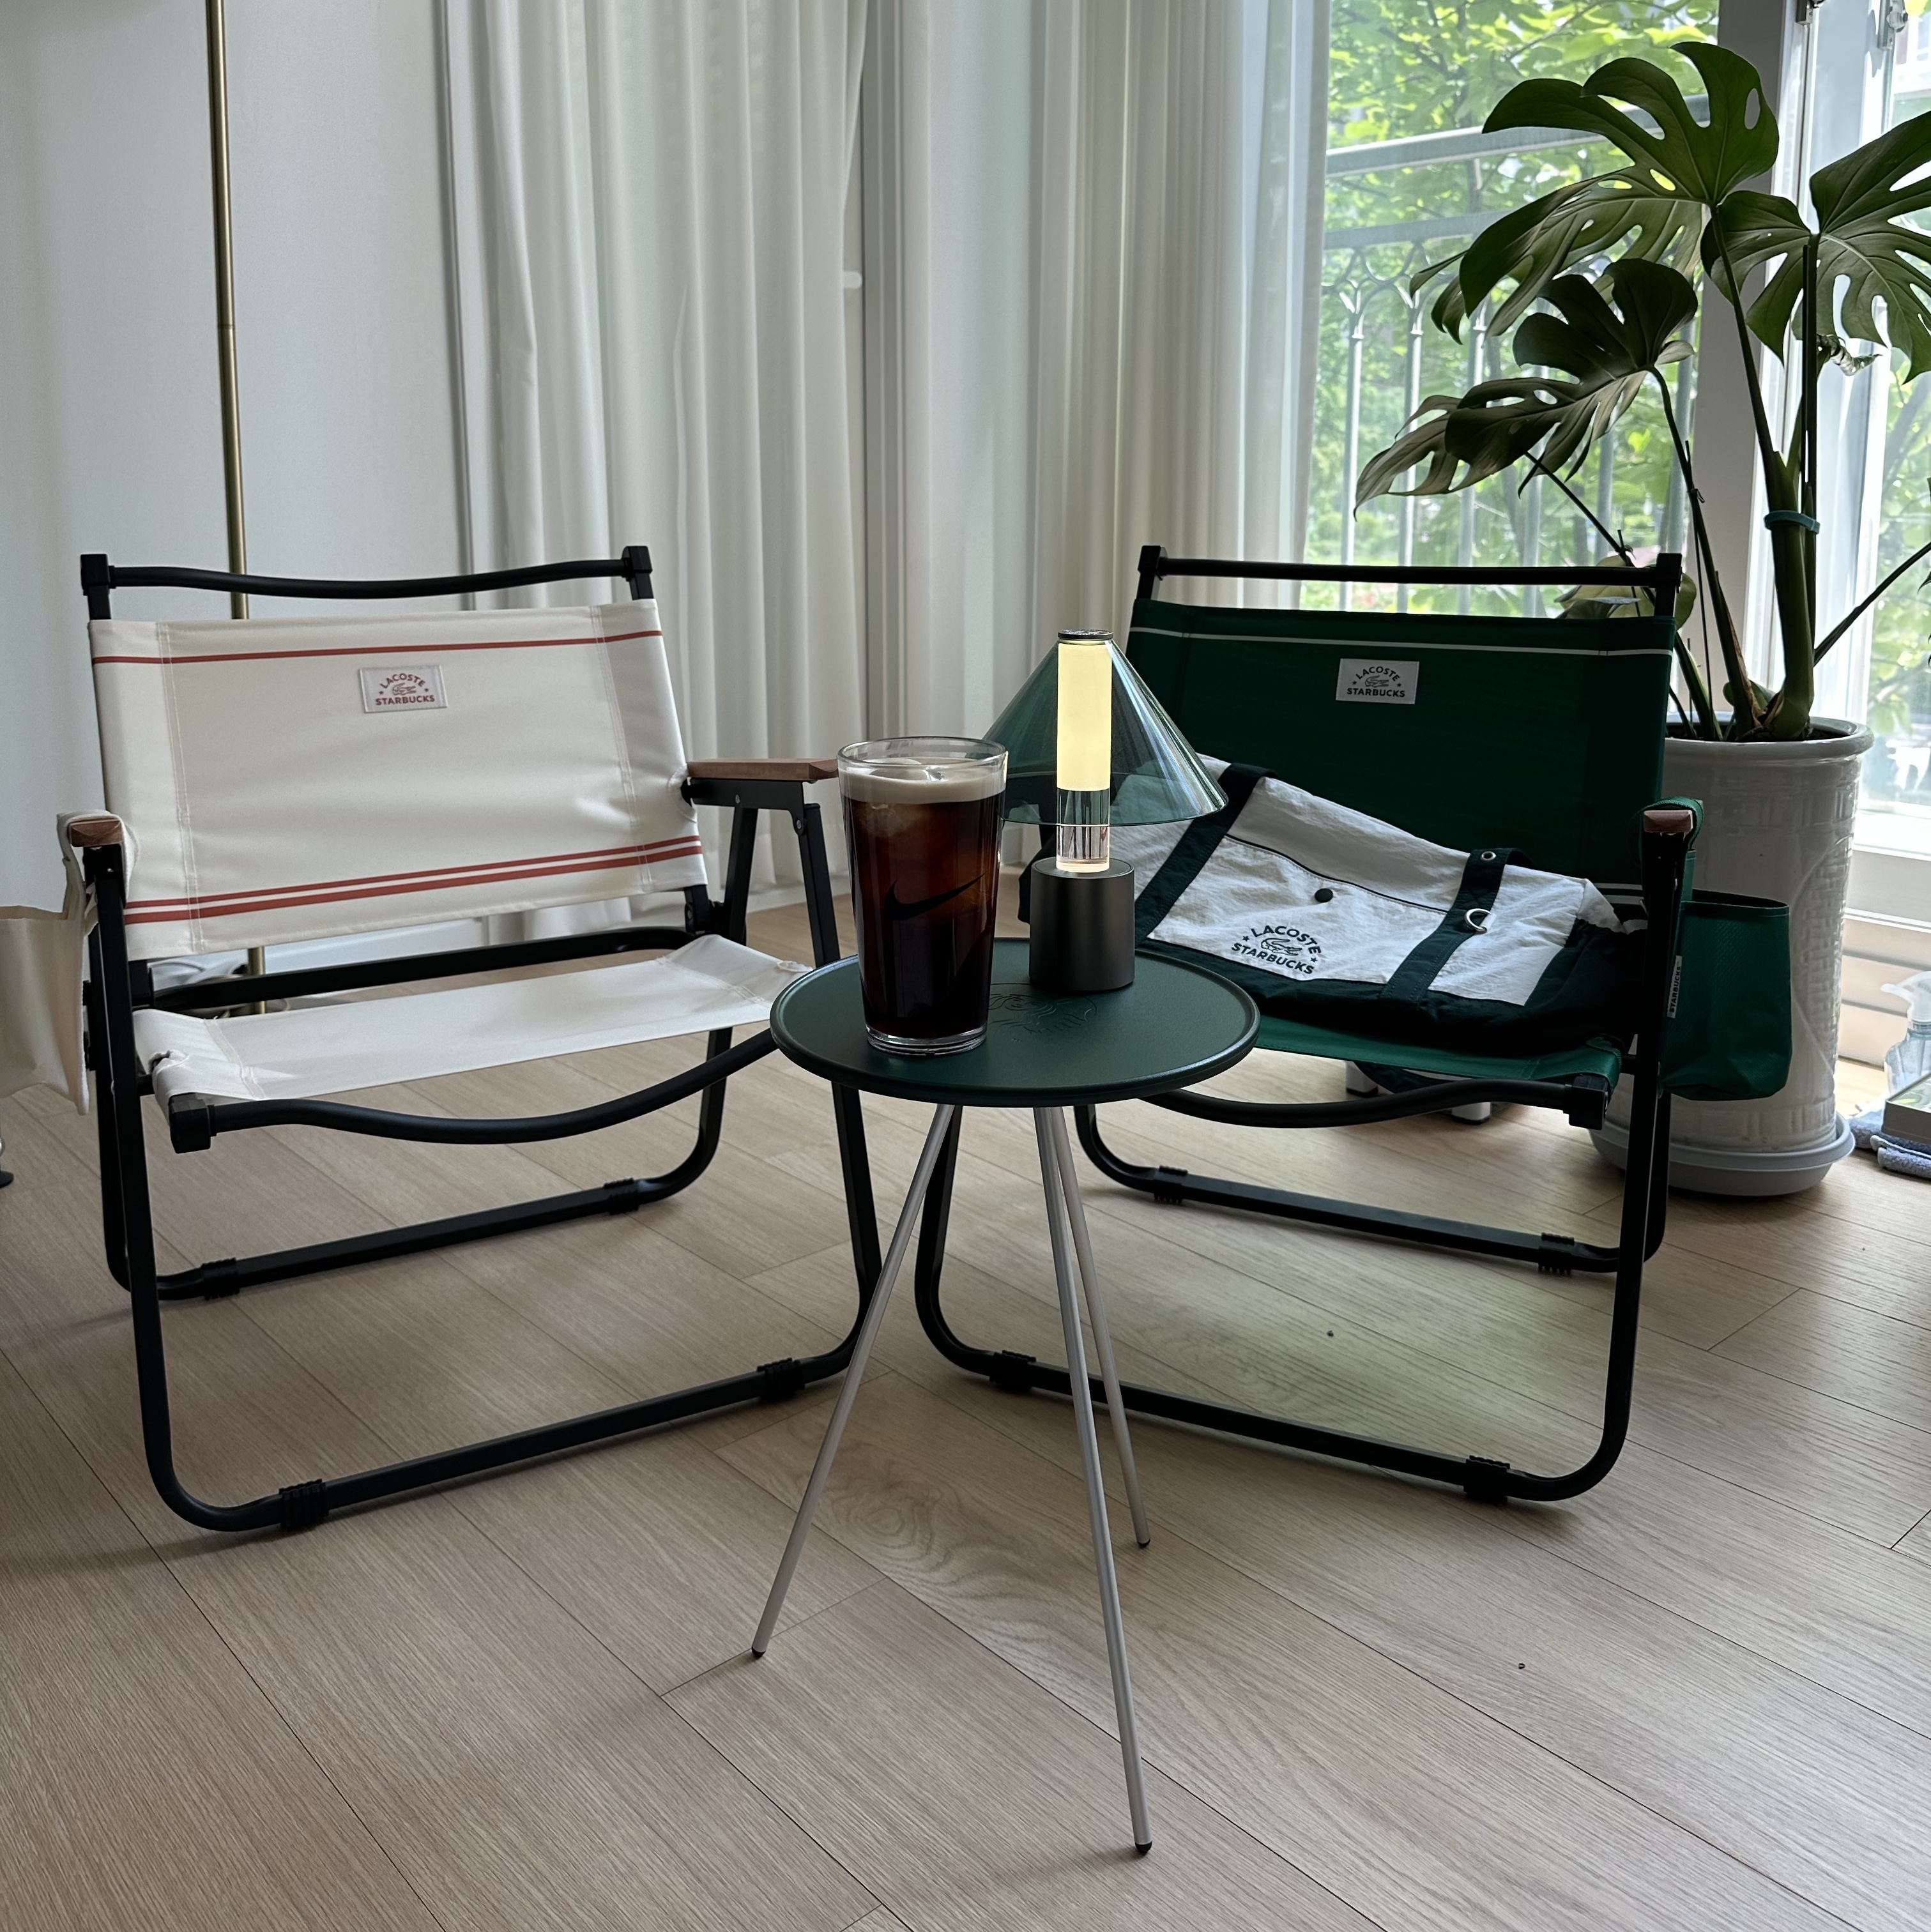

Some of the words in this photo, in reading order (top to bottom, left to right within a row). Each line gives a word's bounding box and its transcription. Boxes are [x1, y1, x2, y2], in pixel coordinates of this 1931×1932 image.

[380, 673, 425, 688] LACOSTE
[1355, 666, 1400, 681] LACOSTE
[1347, 688, 1405, 697] STARBUCKS
[376, 695, 435, 706] STARBUCKS
[1251, 925, 1322, 954] LACOSTE
[1231, 942, 1315, 975] STARBUCKS
[1669, 966, 1681, 1013] STARBUCKS
